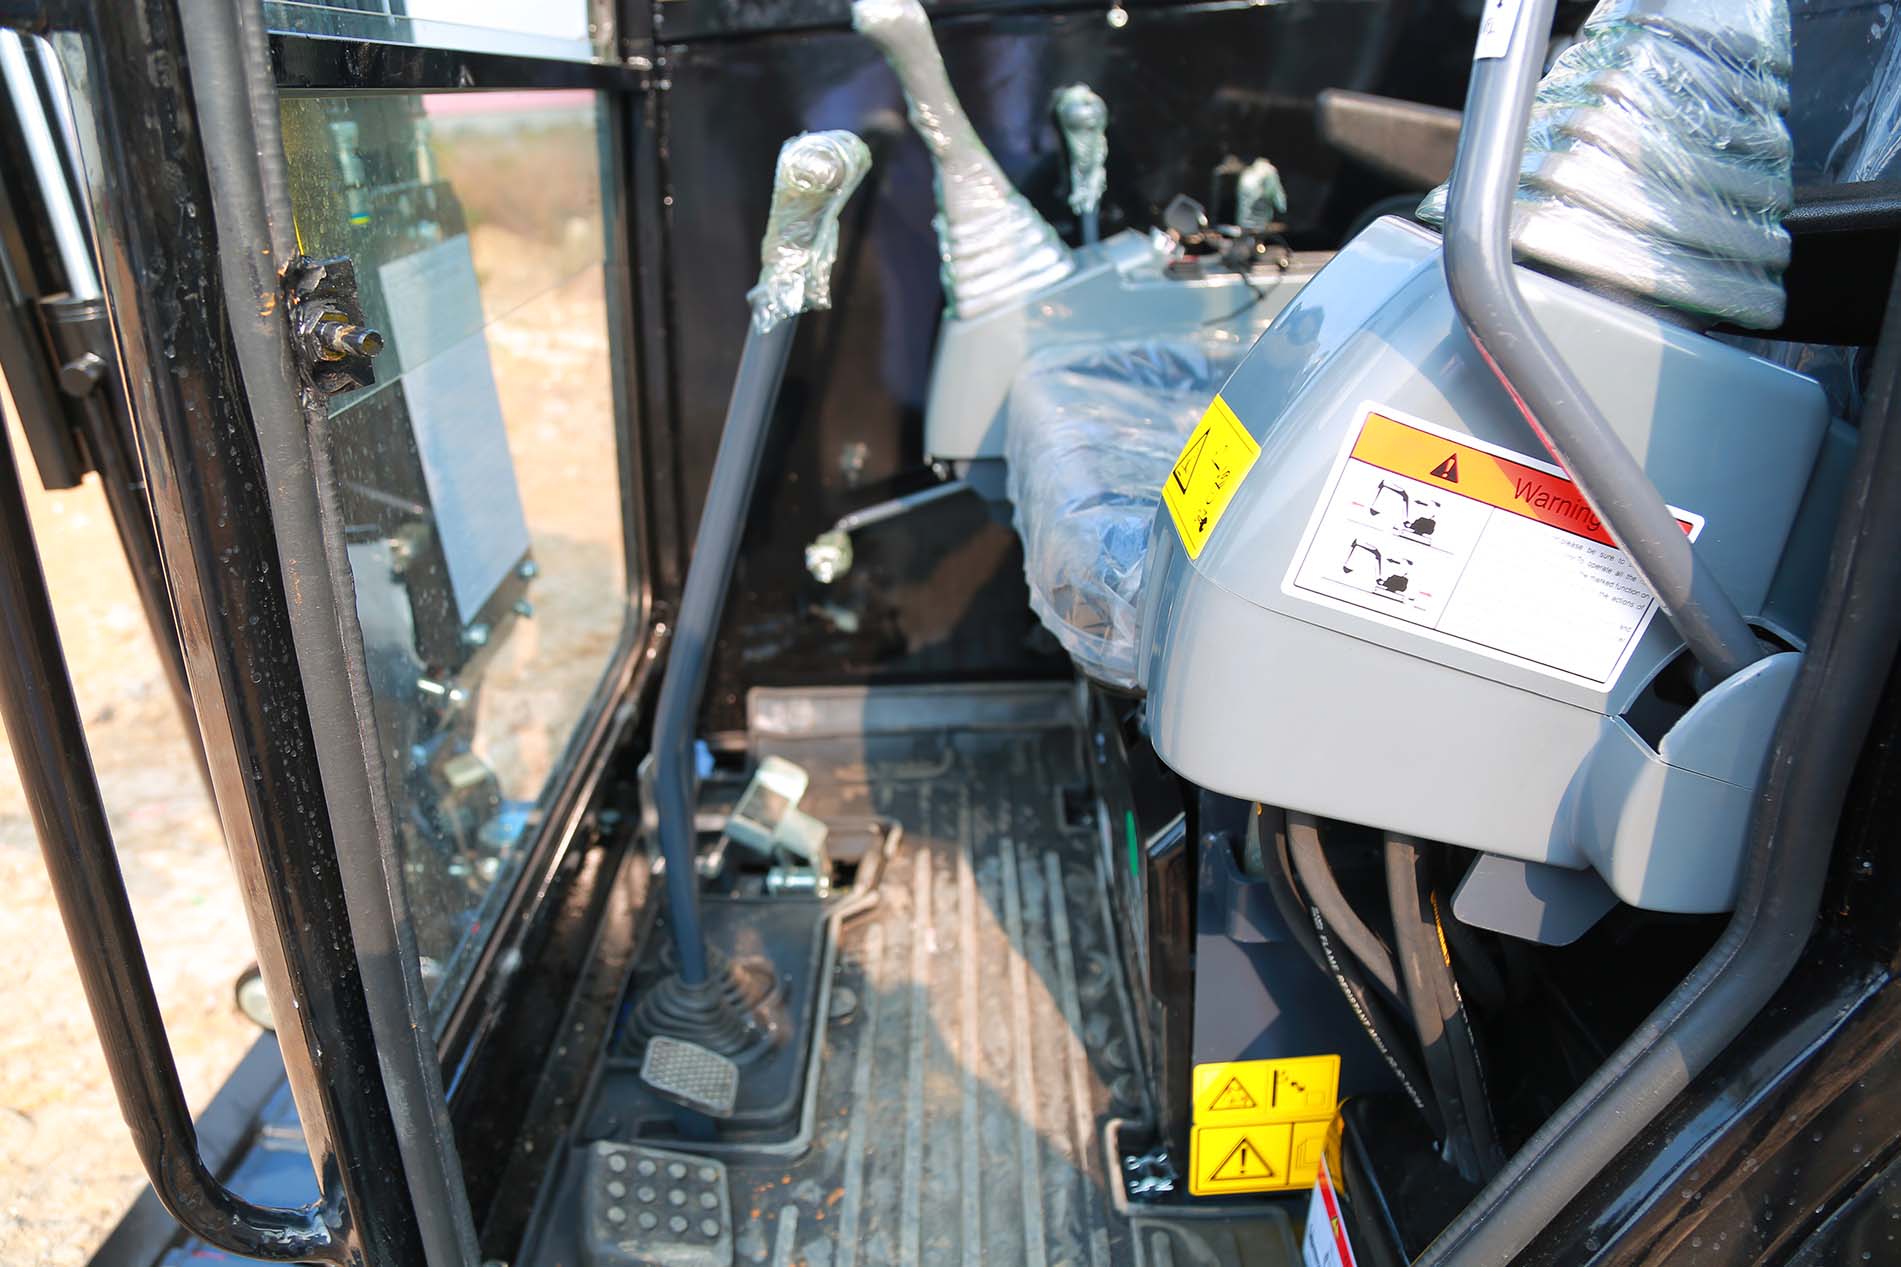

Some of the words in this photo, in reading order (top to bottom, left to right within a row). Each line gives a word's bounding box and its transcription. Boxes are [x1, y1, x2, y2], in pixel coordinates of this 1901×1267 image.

[1514, 477, 1601, 531] Warning
[1587, 546, 1596, 555] be
[1599, 552, 1615, 561] sure
[1618, 556, 1626, 565] to
[1587, 561, 1612, 574] operate
[1614, 583, 1640, 597] function
[1641, 591, 1650, 599] on
[1611, 597, 1634, 608] actions
[1635, 603, 1646, 611] of
[1320, 934, 1340, 971] FLAME
[1336, 974, 1371, 1026] RESISTANT
